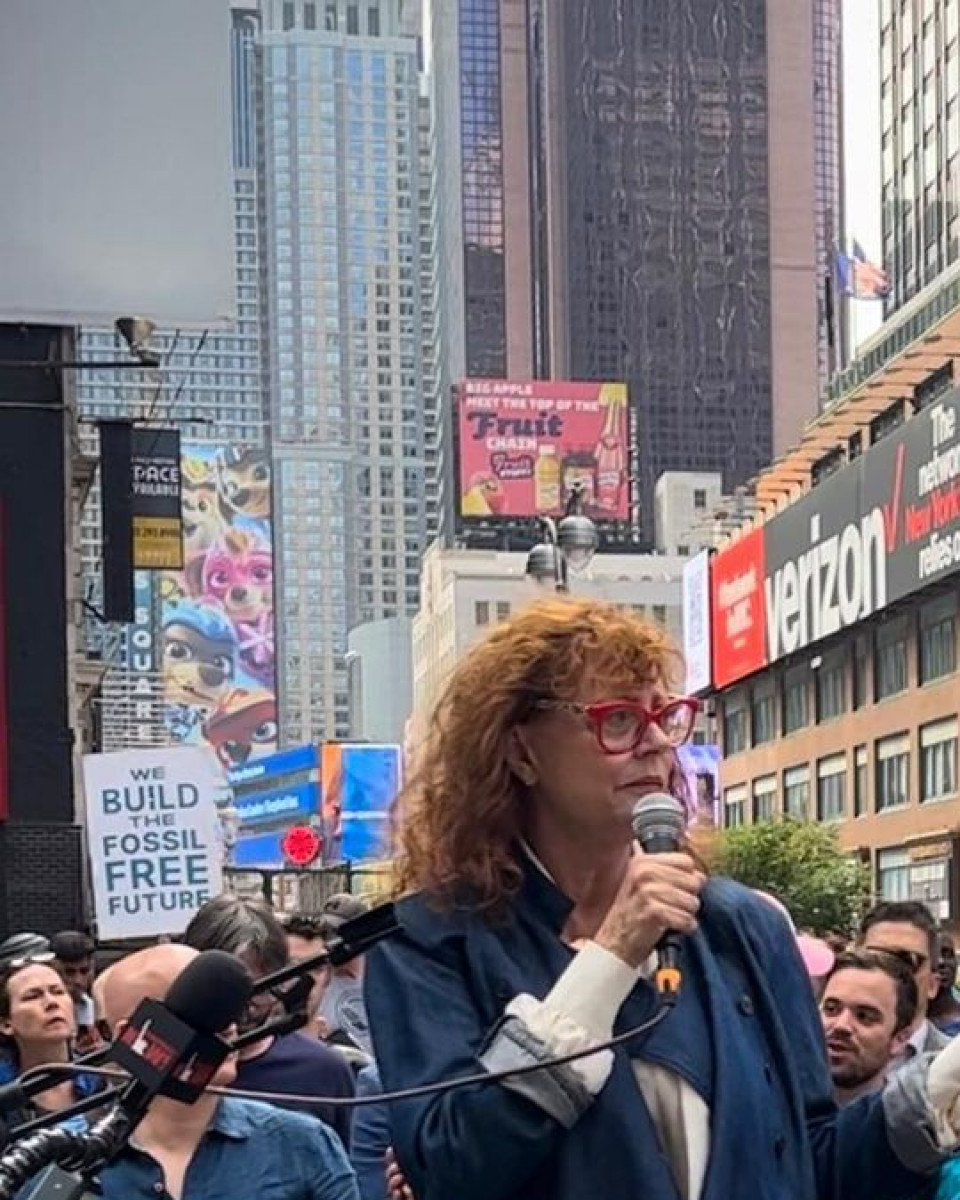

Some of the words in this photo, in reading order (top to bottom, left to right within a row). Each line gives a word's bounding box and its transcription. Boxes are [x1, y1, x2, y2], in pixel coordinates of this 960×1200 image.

[465, 383, 490, 394] BIG
[493, 384, 533, 395] APPLE
[465, 397, 499, 408] MEET
[501, 398, 526, 410] THE
[529, 400, 553, 410] TOP
[555, 401, 571, 410] OF
[575, 402, 599, 411] THE
[467, 411, 562, 440] Fruit
[929, 404, 957, 446] The
[485, 438, 538, 450] CHAIN
[918, 530, 953, 579] relies
[764, 507, 886, 664] verizon
[130, 766, 166, 781] WE
[102, 783, 200, 814] BUILD
[128, 813, 175, 828] THE
[103, 829, 206, 857] FOSSIL
[104, 854, 209, 892] FREE
